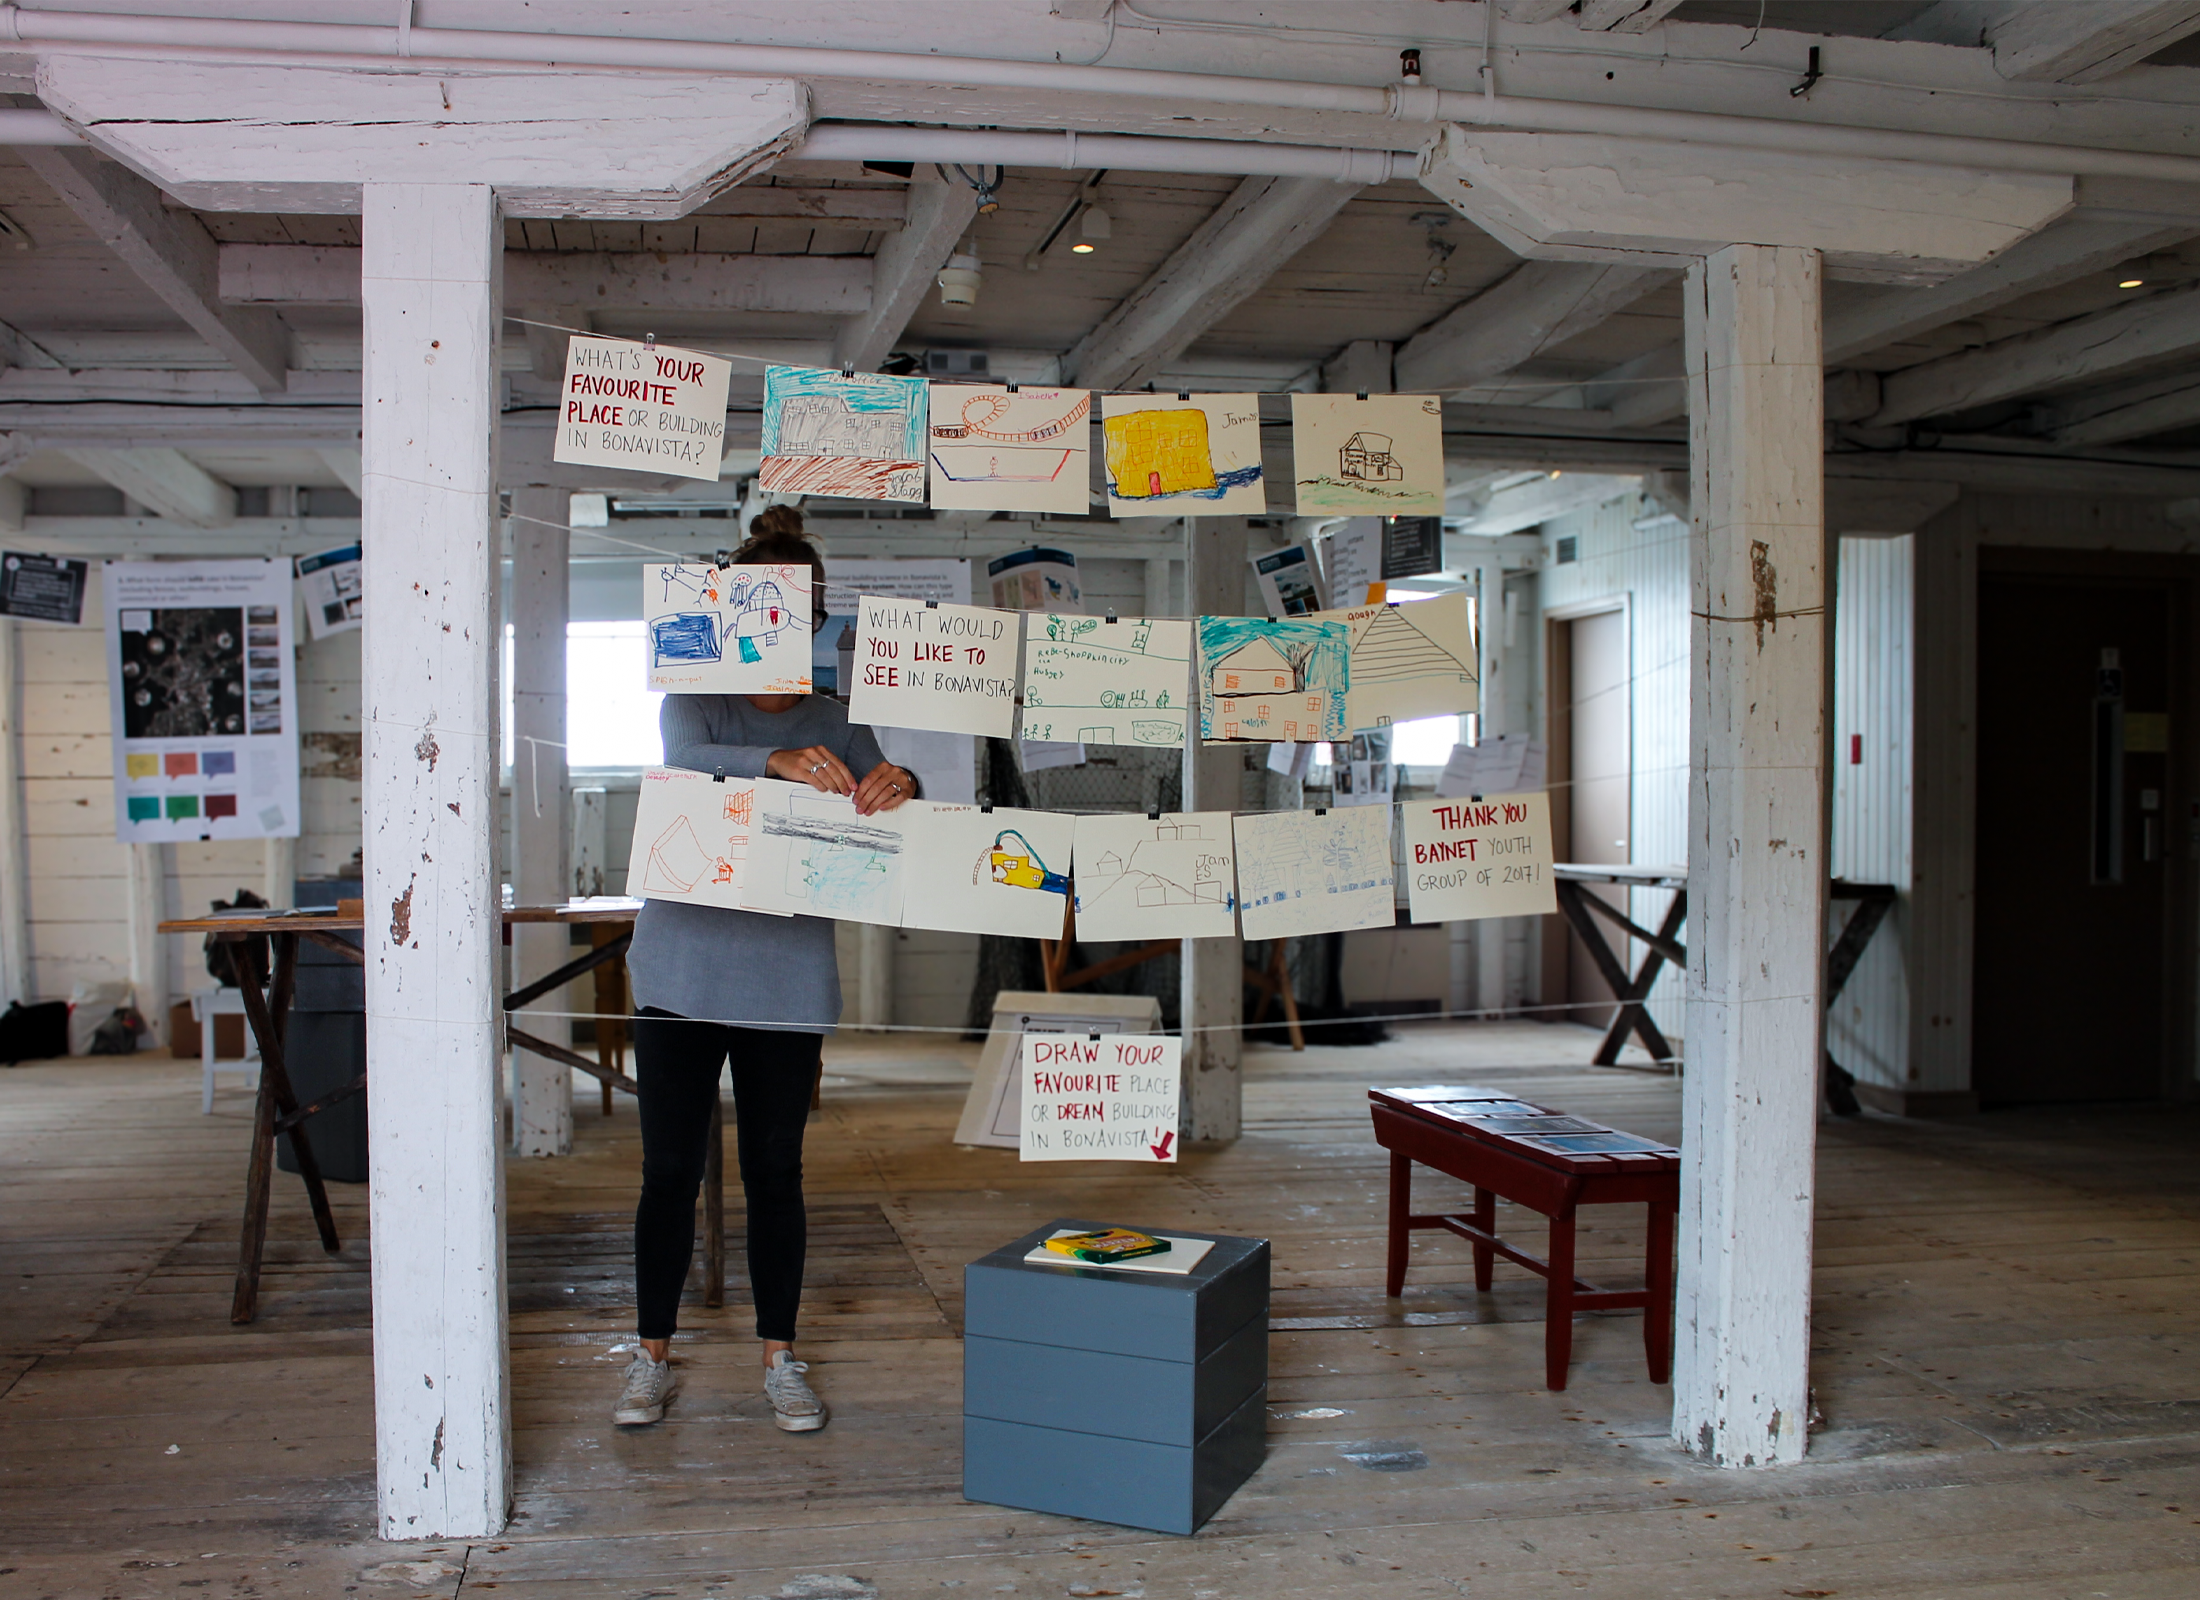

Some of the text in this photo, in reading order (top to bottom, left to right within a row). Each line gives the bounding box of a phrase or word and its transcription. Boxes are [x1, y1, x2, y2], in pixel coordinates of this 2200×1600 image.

[575, 346, 705, 387] WHAT'S YOUR
[570, 373, 678, 406] FAVOURITE
[567, 400, 724, 439] PLACE OR BUILDING
[568, 427, 707, 466] IN BONAVISTA?
[825, 591, 857, 599] nstruction
[825, 601, 847, 609] xtreme
[868, 605, 1004, 641] WHAT WOULD
[867, 636, 986, 666] YOU LIKE TO
[863, 663, 1017, 701] SEE IN BONAVISTA?
[1431, 802, 1528, 831] THANK YOU
[1414, 835, 1532, 865] BAYNET YOUTH
[1416, 862, 1540, 892] GROUP OF 2017!
[1034, 1041, 1164, 1067] DRAW YOUR
[1033, 1071, 1171, 1096] FAVOURITE PLACE
[1031, 1104, 1050, 1123] OR
[1112, 1101, 1177, 1123] BUILDING
[1030, 1130, 1050, 1149] IN
